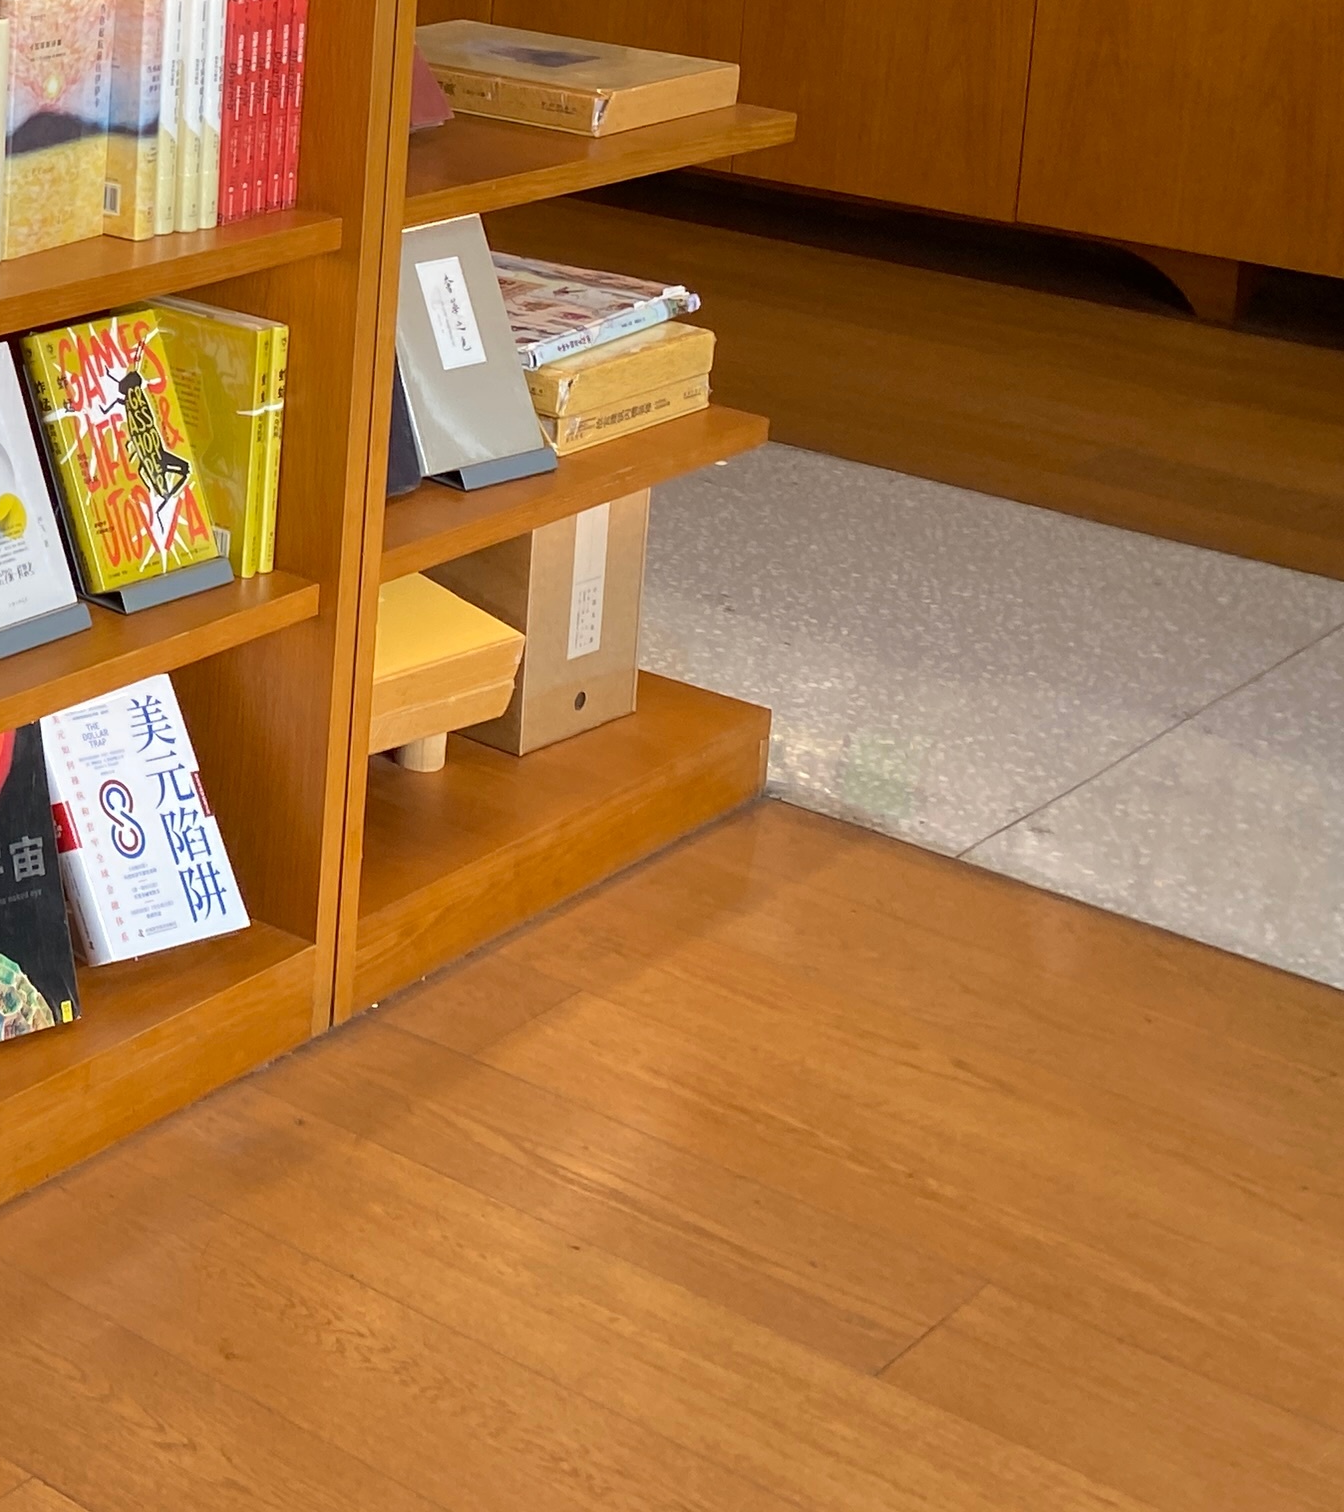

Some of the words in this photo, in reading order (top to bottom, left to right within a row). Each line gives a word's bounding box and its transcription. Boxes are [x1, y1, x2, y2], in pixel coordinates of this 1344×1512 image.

[85, 721, 100, 731] THE
[81, 728, 110, 741] DOLLAR
[88, 738, 107, 749] TRAP
[127, 695, 228, 923] 美元陷阱
